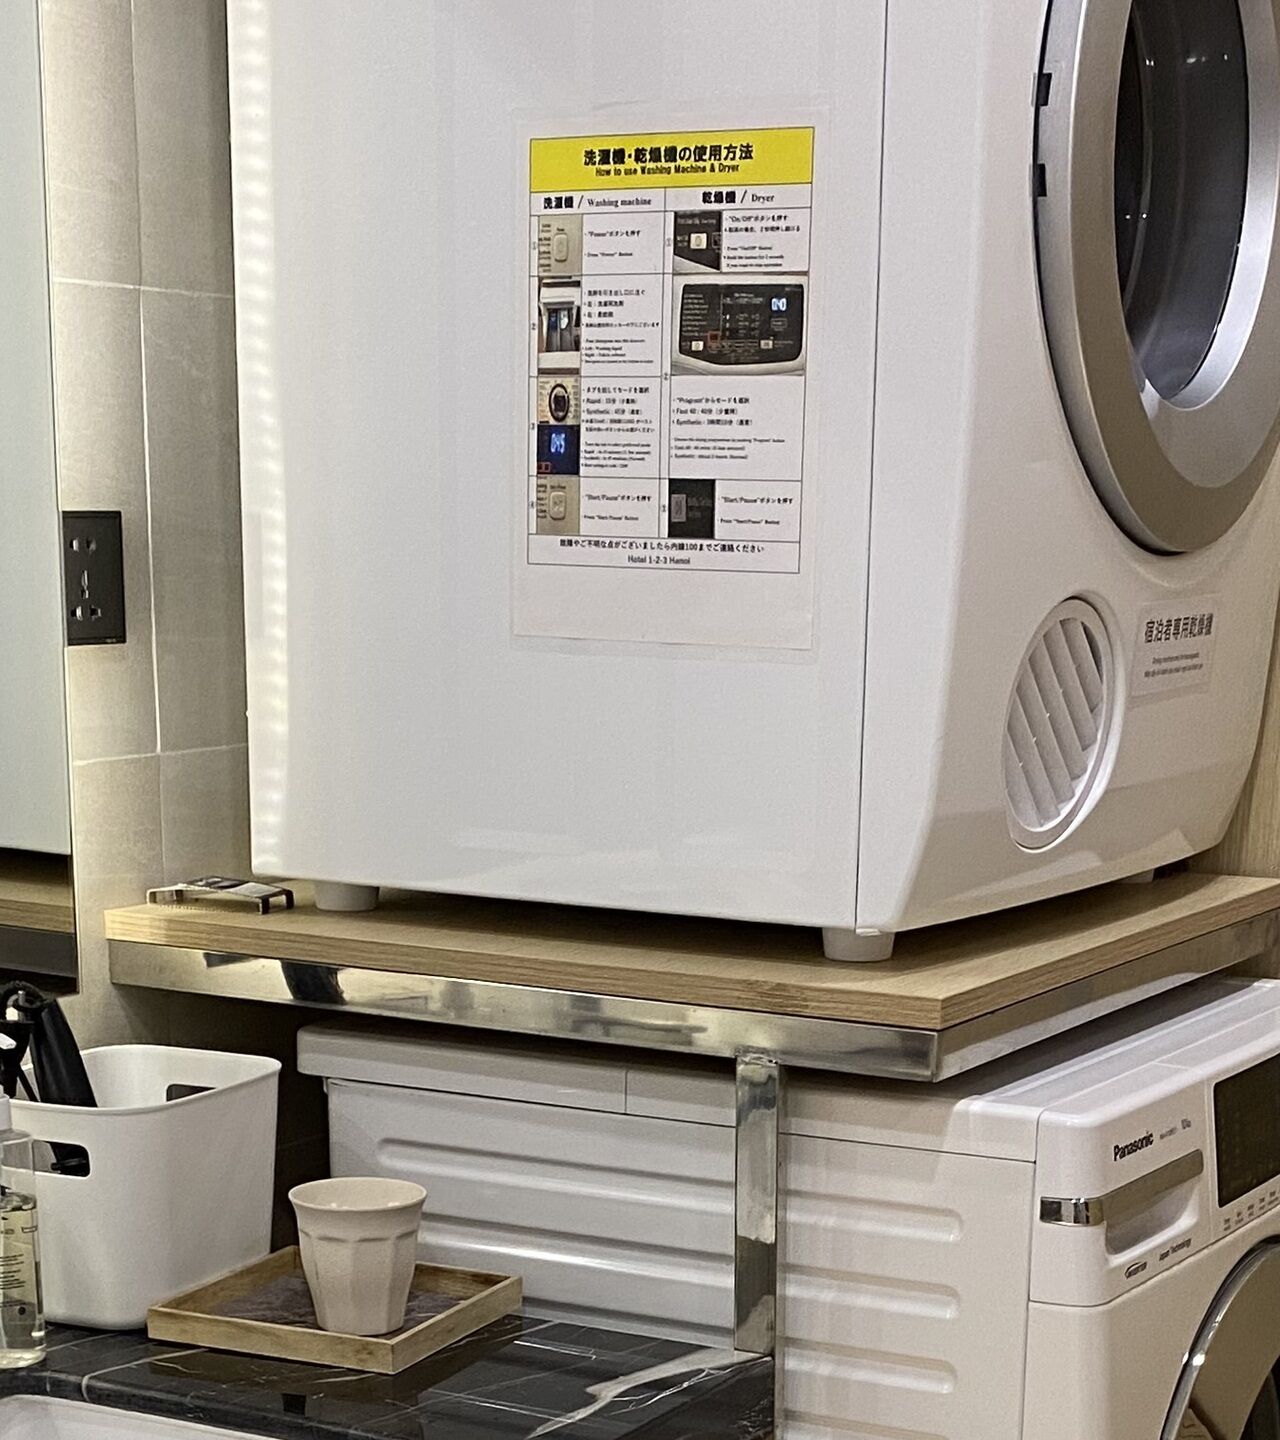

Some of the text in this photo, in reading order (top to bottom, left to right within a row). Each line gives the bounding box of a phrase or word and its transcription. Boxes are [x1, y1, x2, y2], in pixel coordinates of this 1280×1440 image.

[583, 143, 754, 166] 洗濯機・乾燥機の使用方法
[596, 163, 740, 176] How to use Washing Machine & Dryer
[587, 197, 619, 208] Washing
[620, 197, 651, 206] machine
[751, 193, 775, 204] Dryer
[628, 555, 691, 565] Hotel 1-2-3 Hanoi
[1114, 1130, 1154, 1161] Panasonic
